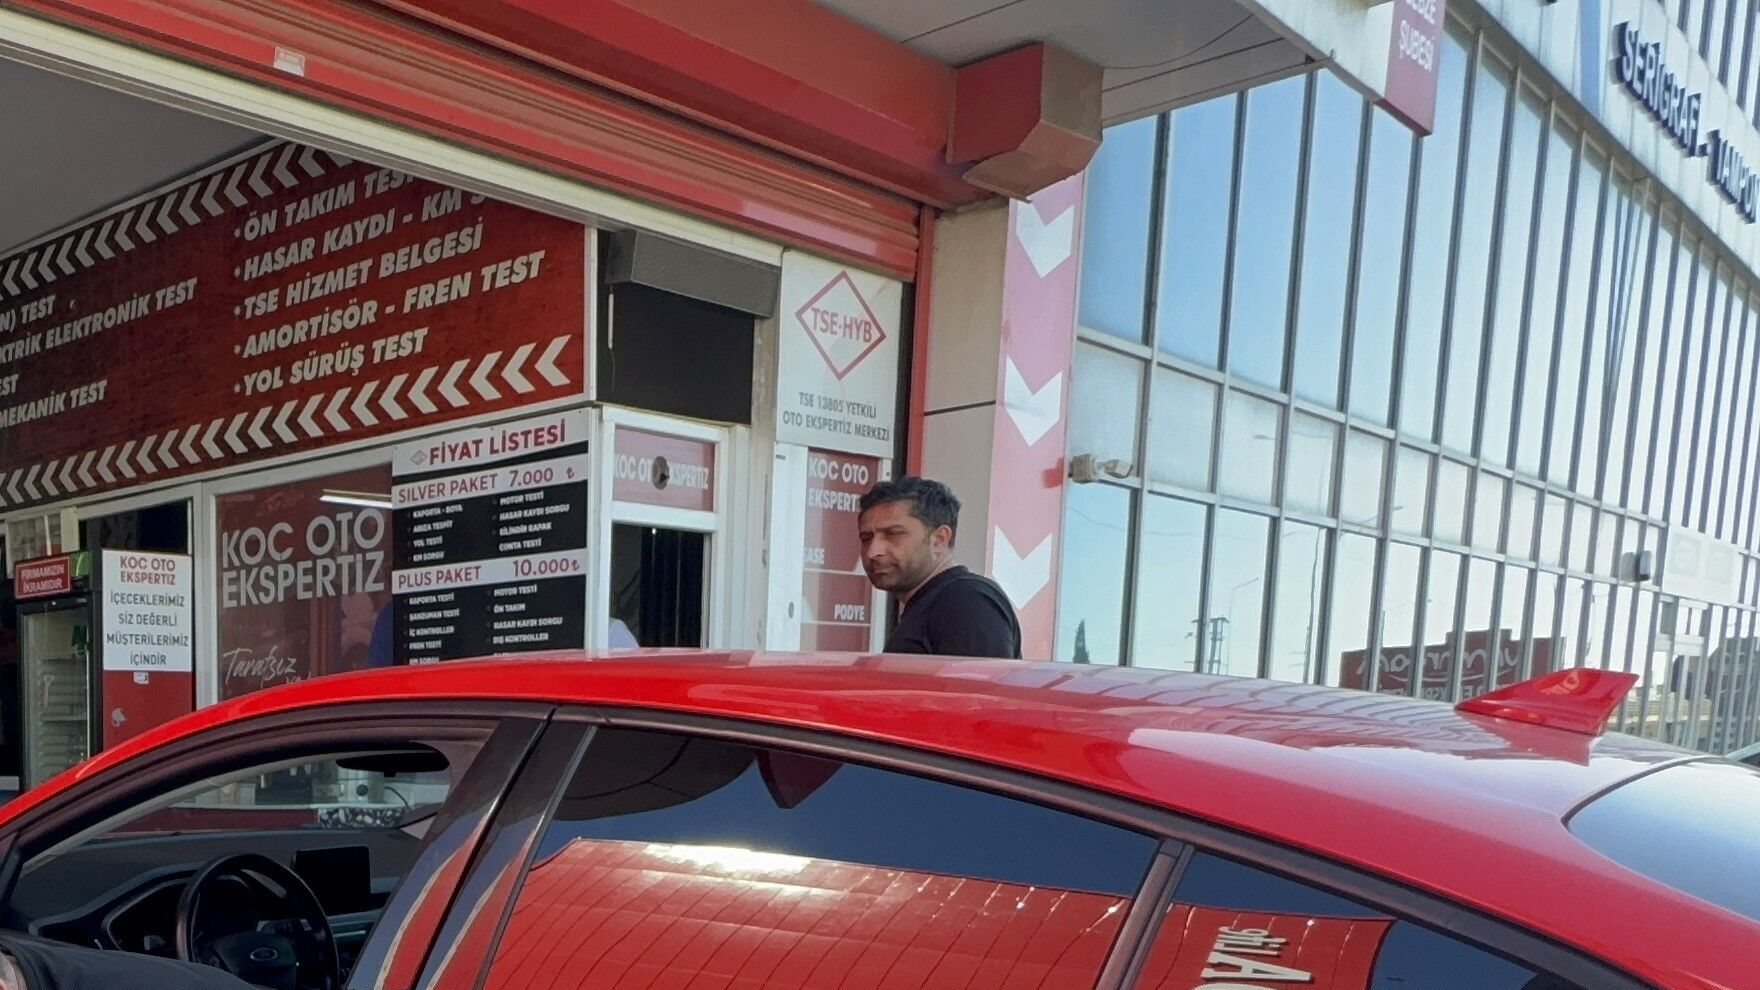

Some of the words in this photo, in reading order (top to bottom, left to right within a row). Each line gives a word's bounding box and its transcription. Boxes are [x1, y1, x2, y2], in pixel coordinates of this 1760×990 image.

[243, 209, 278, 242] ÖN
[284, 180, 356, 228] TAKIM
[243, 236, 316, 282] HASAR
[322, 208, 396, 255] KAYDI
[421, 188, 462, 222] KM
[243, 289, 279, 320] TSE
[285, 258, 373, 307] HİZMET
[379, 216, 484, 279] BELGESİ
[21, 294, 56, 325] TEST
[45, 293, 151, 350] ELEKTRONİK
[155, 277, 198, 312] TEST
[242, 298, 378, 358] AMORTİSÖR
[403, 271, 472, 314] FREN
[481, 250, 545, 292] TEST
[811, 307, 872, 343] TSE-HYB
[243, 366, 283, 396] YOL
[290, 342, 364, 385] SÜRÜŞ
[372, 327, 428, 364] TEST
[70, 379, 108, 409] TEST
[782, 410, 803, 427] OTO
[430, 439, 483, 466] FİYAT
[490, 418, 565, 454] LİSTESİ
[450, 474, 497, 494] PAKET
[509, 468, 553, 487] 7.000
[639, 457, 654, 482] OT
[841, 462, 868, 485] OTO
[306, 508, 385, 556] OTO
[151, 558, 175, 572] OTO
[398, 571, 432, 588] PLUS
[436, 566, 481, 583] PAKET
[119, 611, 134, 625] SİZ
[136, 612, 177, 627] DEĞERLİ
[130, 650, 167, 665] İÇİNDİR
